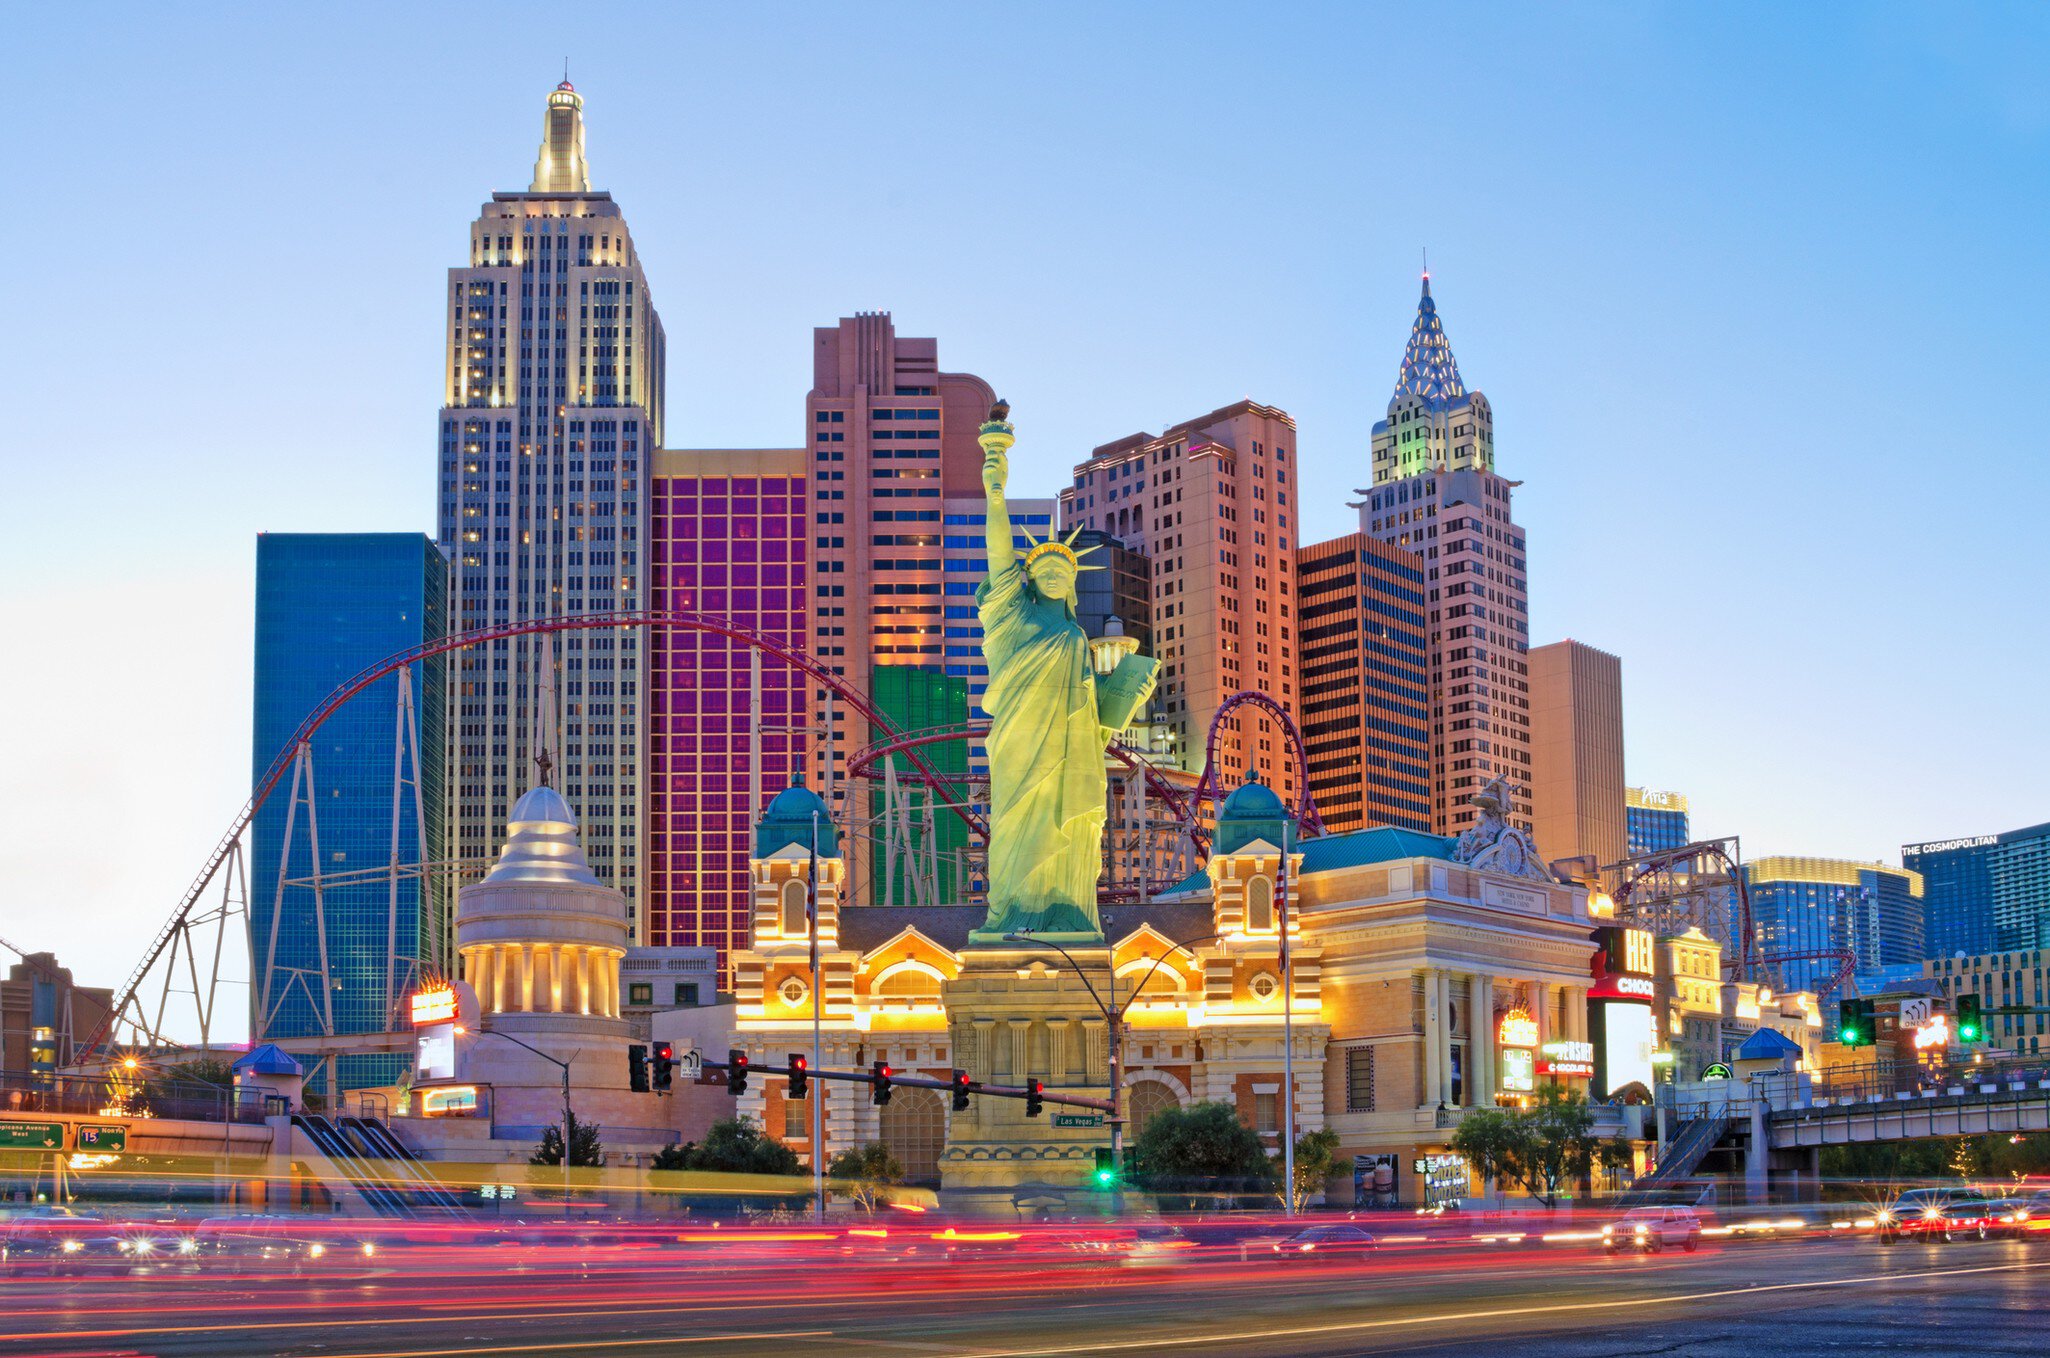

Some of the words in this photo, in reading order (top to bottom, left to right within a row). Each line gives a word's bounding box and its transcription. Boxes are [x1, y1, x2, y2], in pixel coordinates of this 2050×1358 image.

[1641, 785, 1667, 805] Aria
[1902, 845, 1920, 857] THE
[1922, 835, 1997, 854] COSMOPOLITAN
[1060, 1117, 1073, 1125] Las
[1075, 1117, 1093, 1127] Vegas
[85, 1132, 97, 1142] 15
